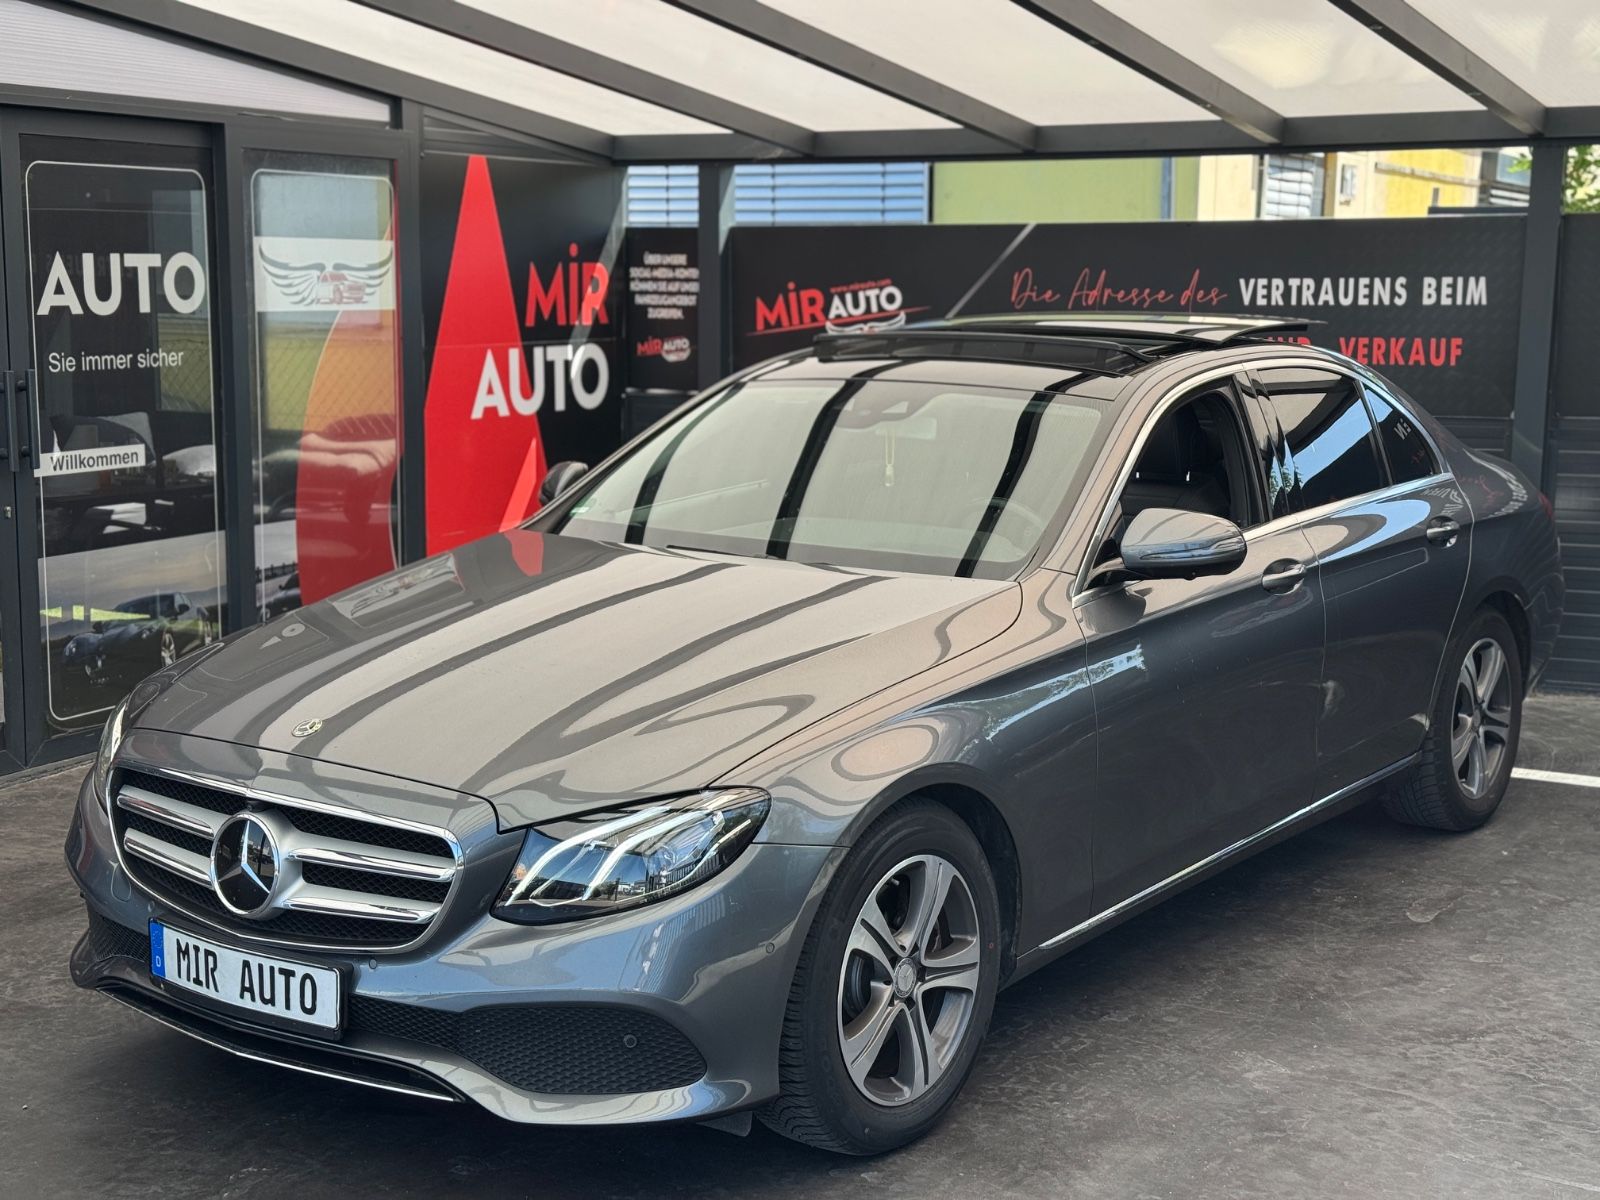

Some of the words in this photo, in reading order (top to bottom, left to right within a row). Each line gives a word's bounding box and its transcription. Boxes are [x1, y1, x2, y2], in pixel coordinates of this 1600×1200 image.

[37, 251, 206, 316] AUTO
[828, 286, 903, 319] AUTO
[1010, 267, 1060, 309] Die
[1068, 267, 1174, 310] Adresse
[1180, 268, 1228, 312] des
[1239, 277, 1408, 306] VERTRAUENS
[1422, 275, 1488, 306] BEIM
[48, 352, 76, 373] Sie
[81, 350, 133, 371] immer
[137, 347, 184, 368] sicher
[1339, 336, 1464, 367] VERKAUF
[470, 343, 609, 420] AUTO
[50, 450, 139, 472] Willkommen
[176, 938, 220, 993] MIR
[239, 958, 318, 1016] AUTO
